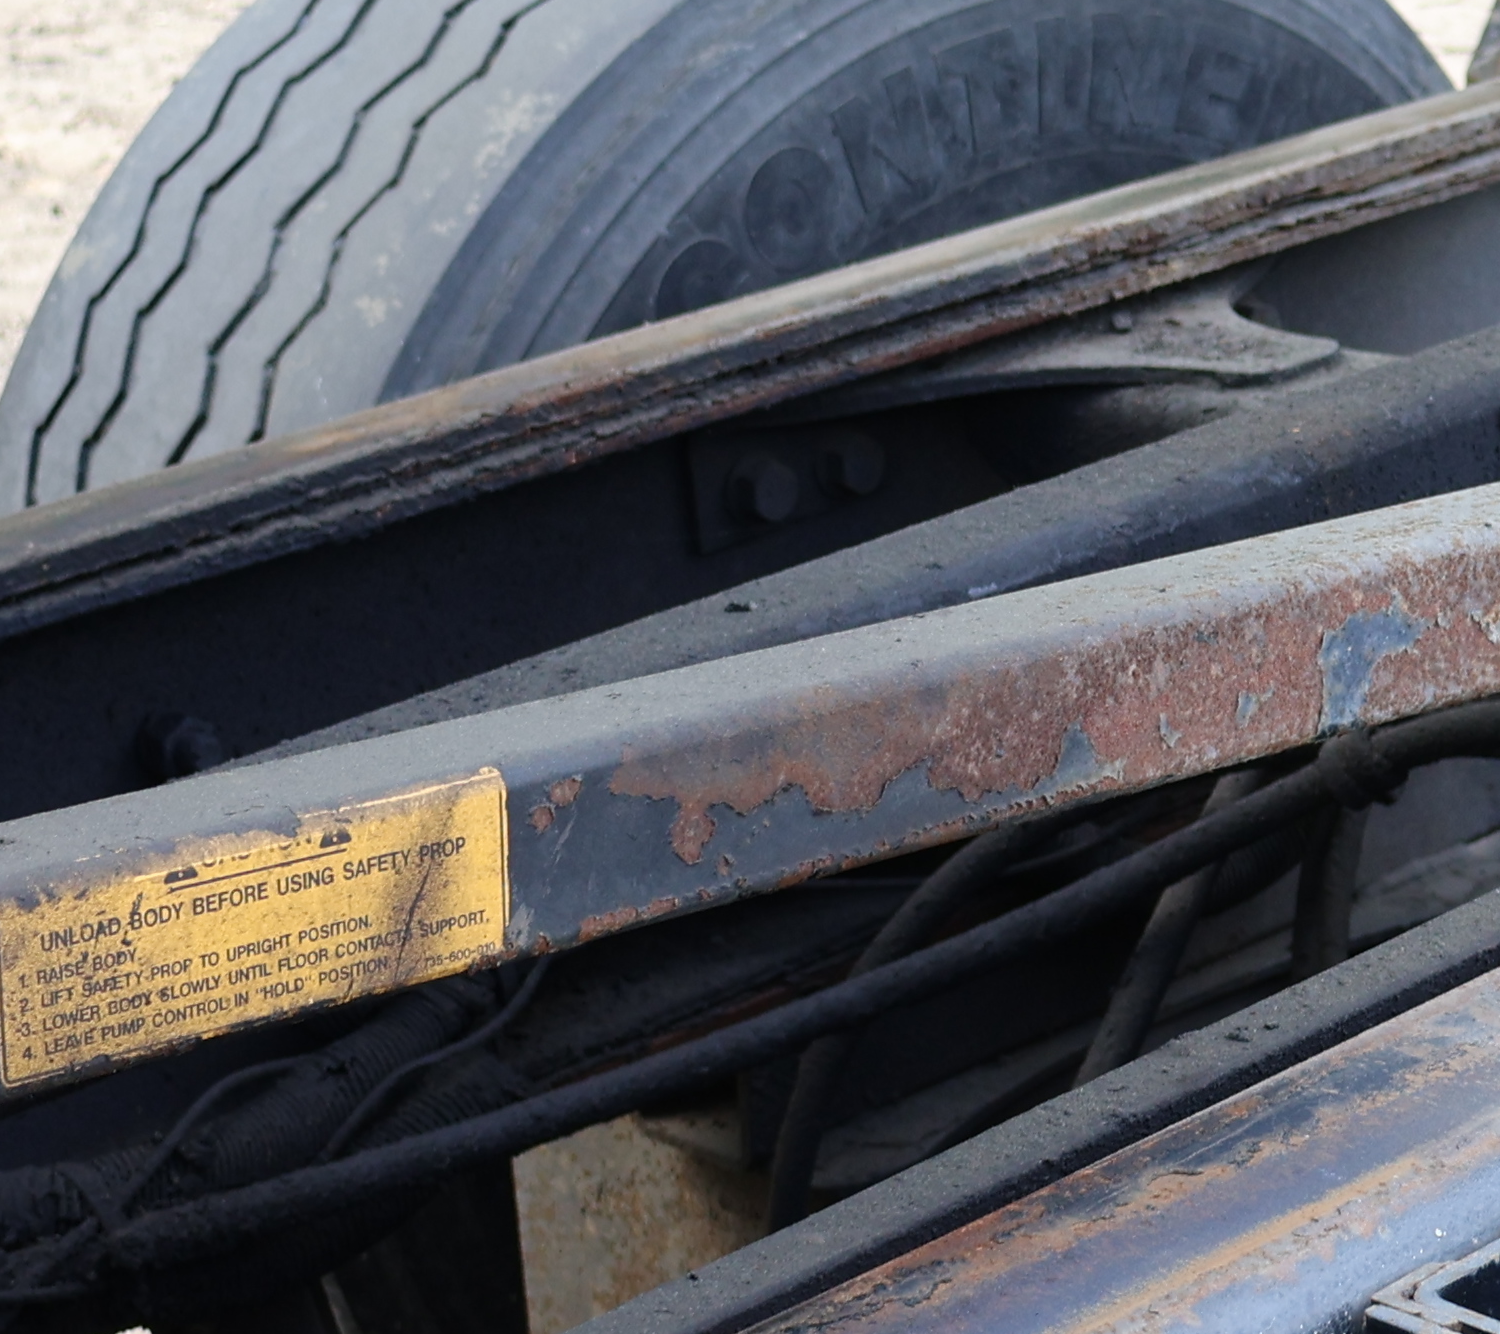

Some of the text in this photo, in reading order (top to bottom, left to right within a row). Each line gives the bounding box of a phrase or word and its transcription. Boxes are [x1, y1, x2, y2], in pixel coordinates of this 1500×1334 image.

[40, 917, 121, 953] UNLOAD
[129, 901, 184, 931] BODY
[193, 882, 269, 915] BEFORE
[277, 867, 334, 896] USING
[343, 849, 411, 880] SAFETY
[419, 837, 466, 865] PROP
[18, 974, 30, 989] 1.
[37, 961, 85, 985] RAISE
[19, 915, 372, 1013] 2. LIFT SAFETY PROP TO UPRIGHT POSITION.
[20, 1022, 36, 1038] 3.
[43, 1005, 100, 1032] LOWER
[108, 992, 153, 1015] BODY
[160, 975, 221, 1003] SLOWLY
[229, 964, 272, 985] UNTIL
[278, 948, 329, 972] FLOOR
[335, 929, 413, 959] CONTACTS
[22, 1046, 37, 1061] 4.
[44, 1028, 96, 1055] LEAVE
[100, 1017, 145, 1041] PUMP
[152, 997, 228, 1028] CONTROL
[235, 992, 249, 1007] IN
